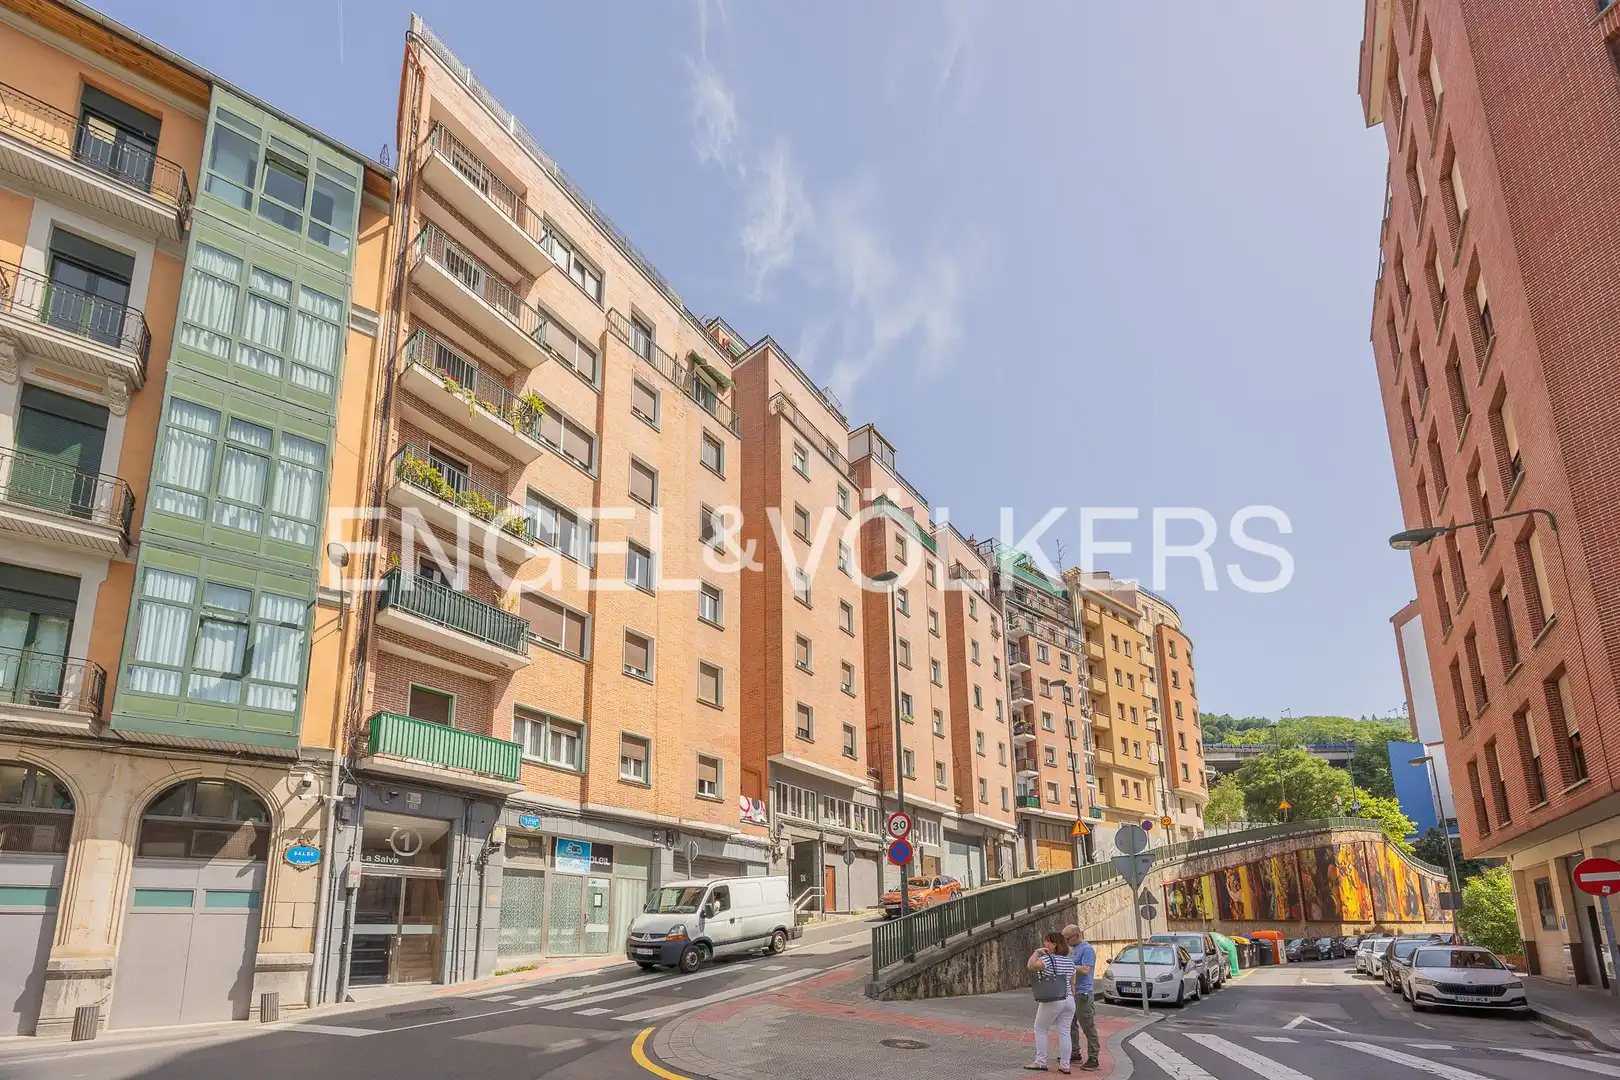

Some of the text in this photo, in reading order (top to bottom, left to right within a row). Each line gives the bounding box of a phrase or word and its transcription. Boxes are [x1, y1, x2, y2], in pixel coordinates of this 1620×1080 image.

[893, 821, 906, 830] 30
[360, 853, 399, 864] La Salve
